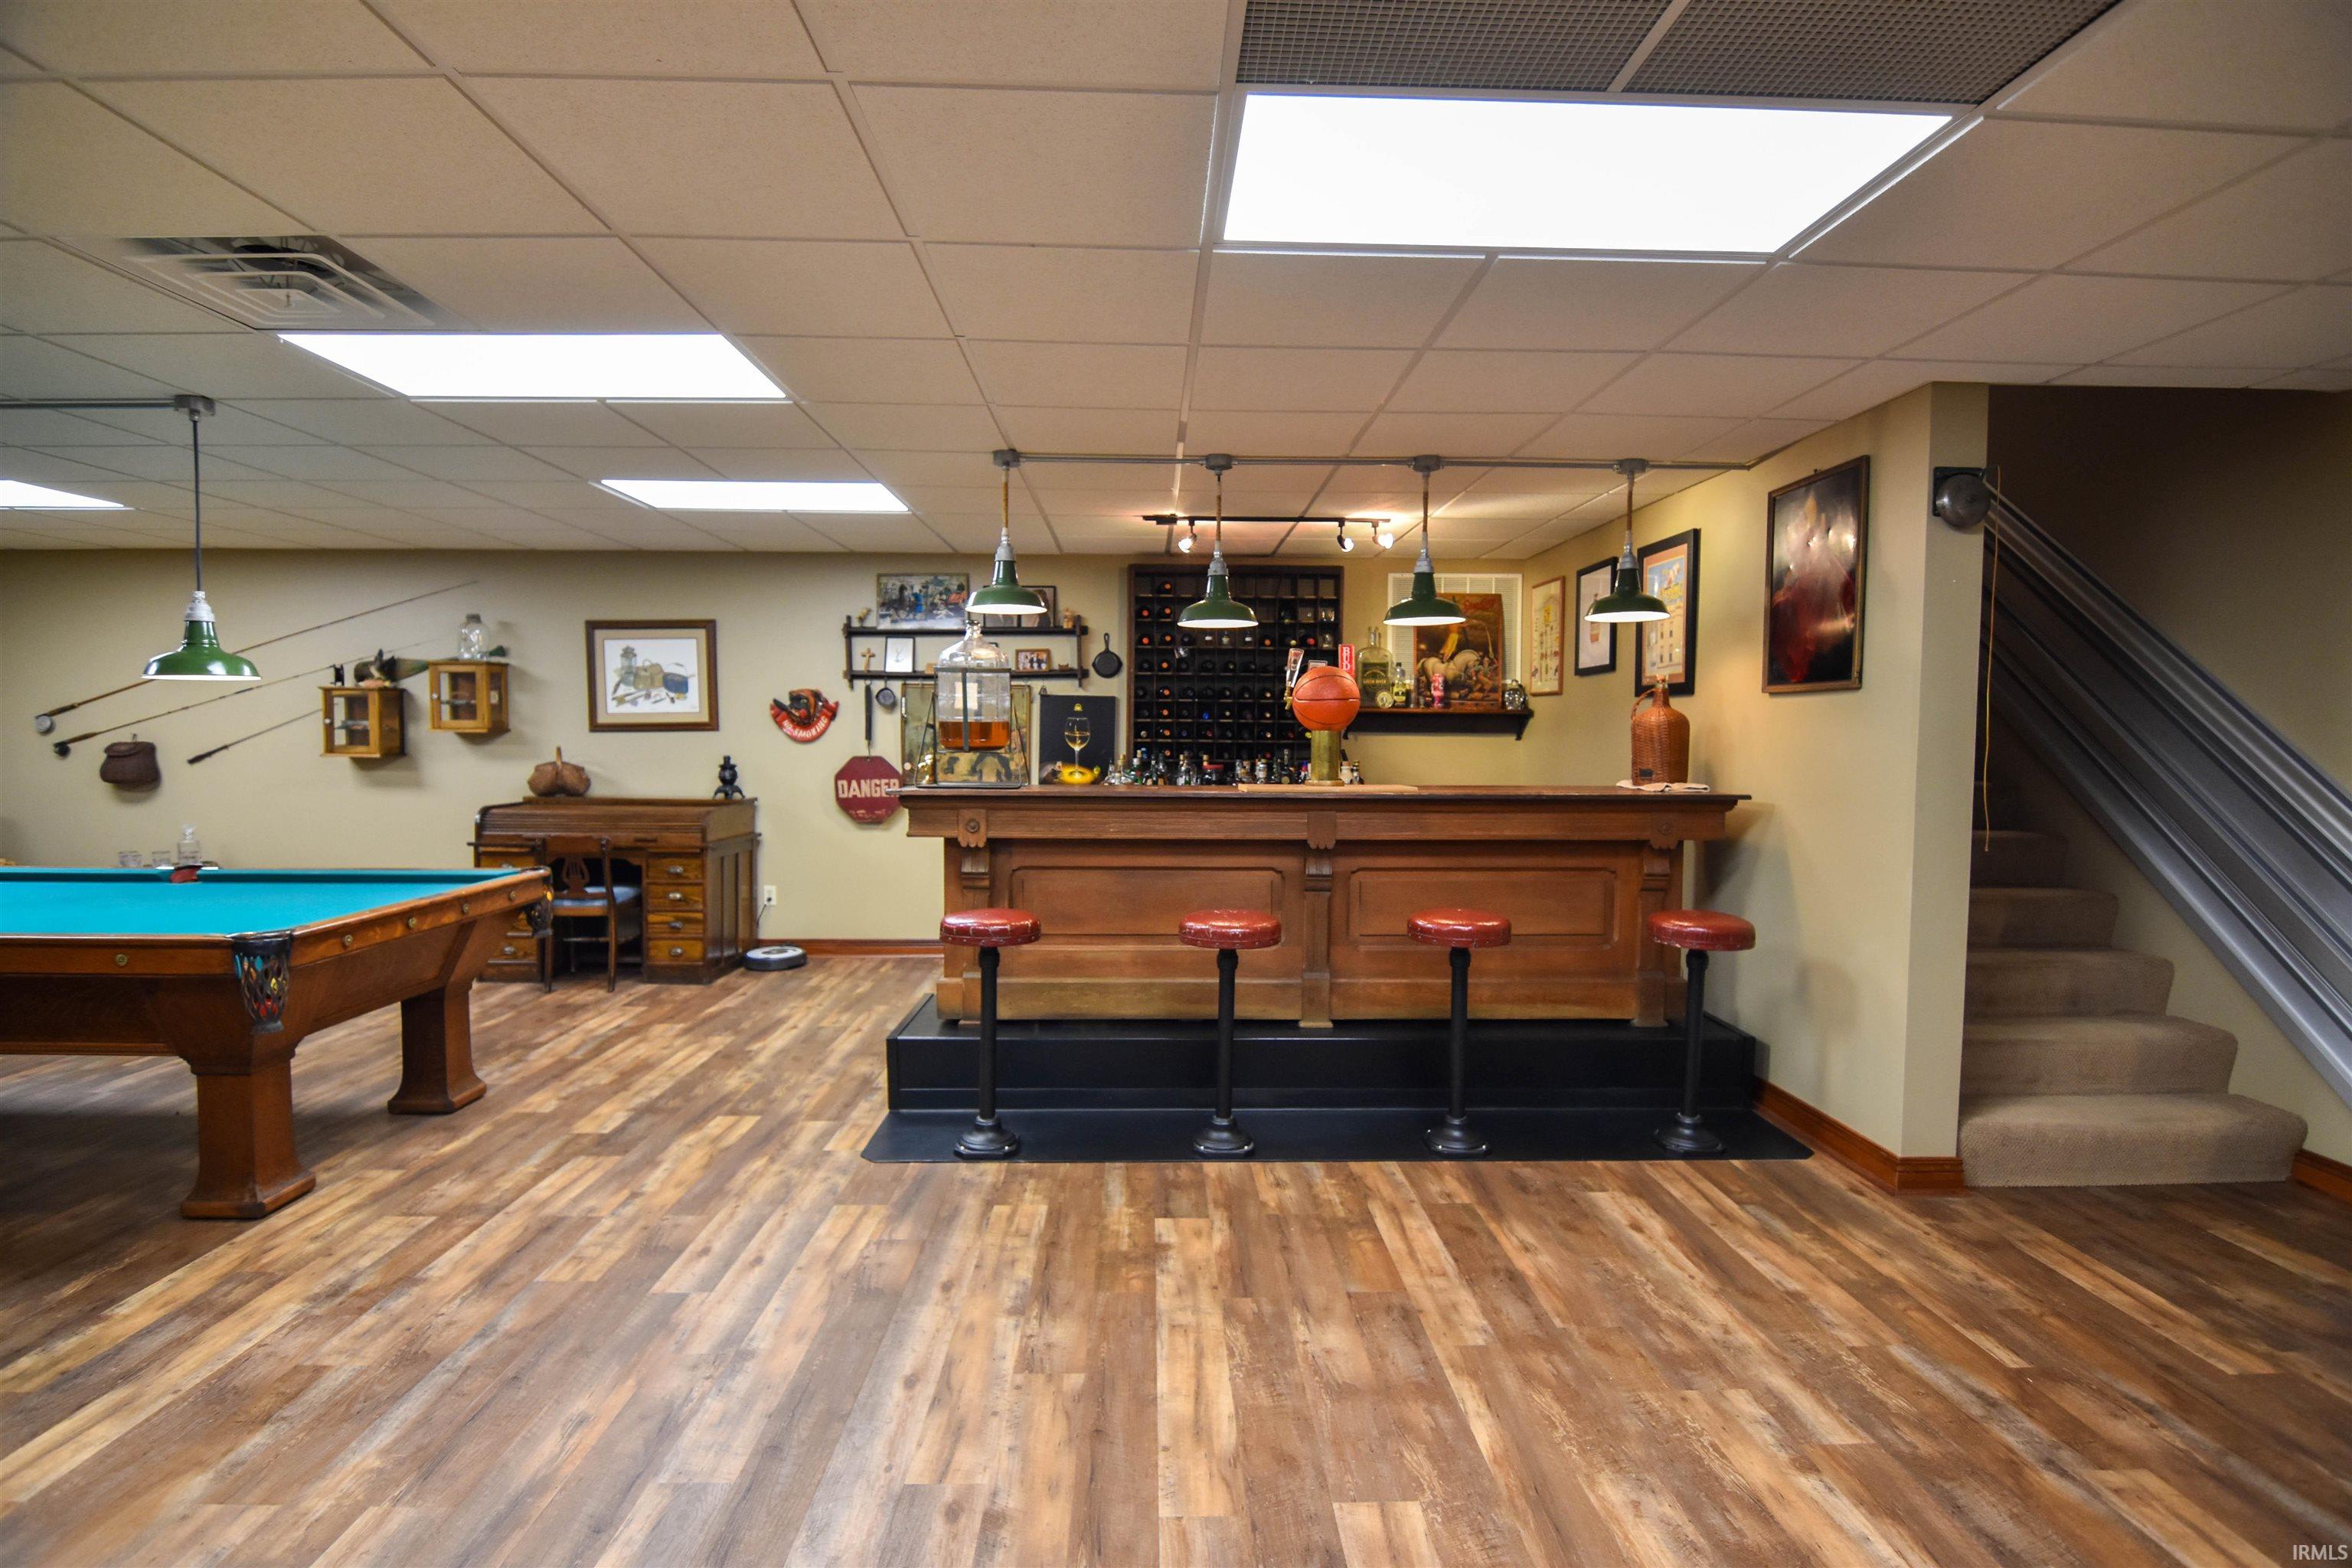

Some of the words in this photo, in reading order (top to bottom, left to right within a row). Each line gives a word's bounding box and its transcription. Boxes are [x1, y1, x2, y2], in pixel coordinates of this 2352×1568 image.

[1342, 646, 1351, 671] BUD
[792, 716, 828, 739] SMOKING
[837, 778, 900, 799] DANGER
